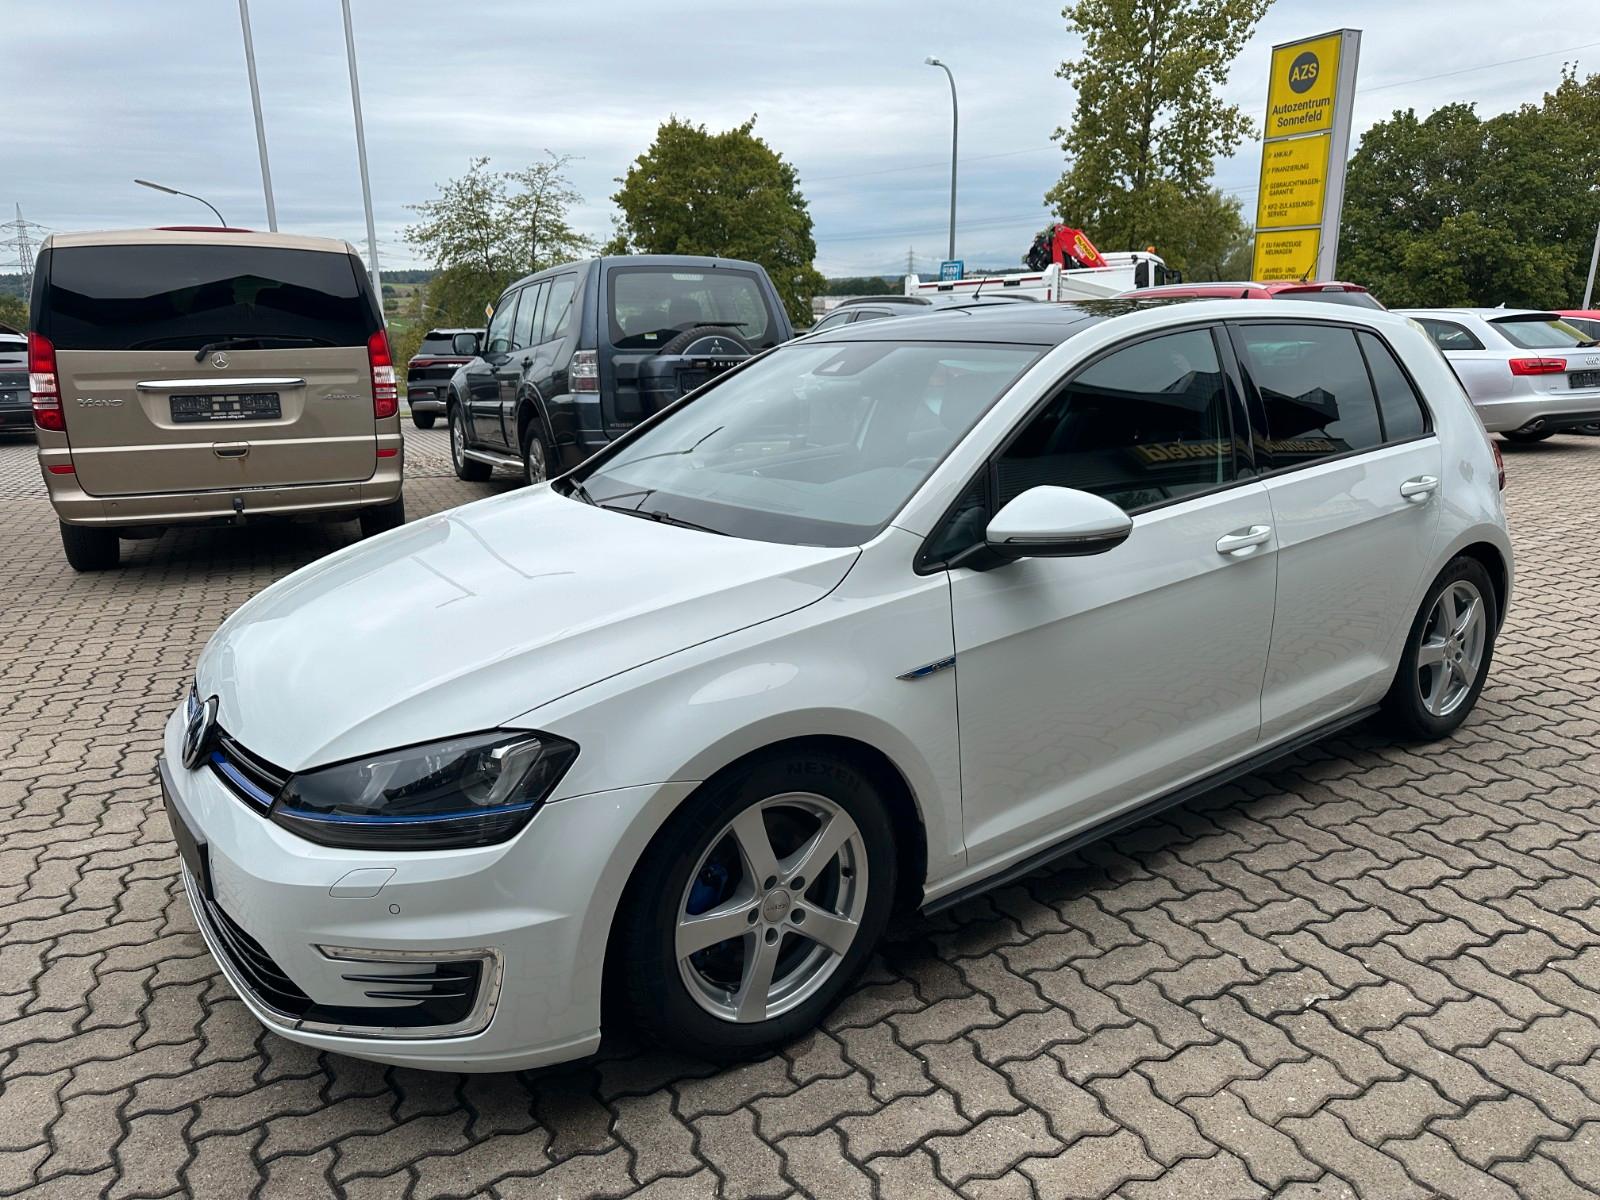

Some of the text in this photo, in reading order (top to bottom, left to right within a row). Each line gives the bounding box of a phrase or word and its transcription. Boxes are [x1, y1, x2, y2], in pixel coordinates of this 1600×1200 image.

[1291, 62, 1317, 82] AZS
[1272, 97, 1330, 115] Autozentrum
[1277, 110, 1322, 127] Sonnefeld
[1272, 163, 1309, 174] FINANZIERUNG
[1269, 188, 1294, 197] GARANTIE
[1267, 210, 1288, 218] SERVICE
[786, 761, 860, 792] NEXEN
